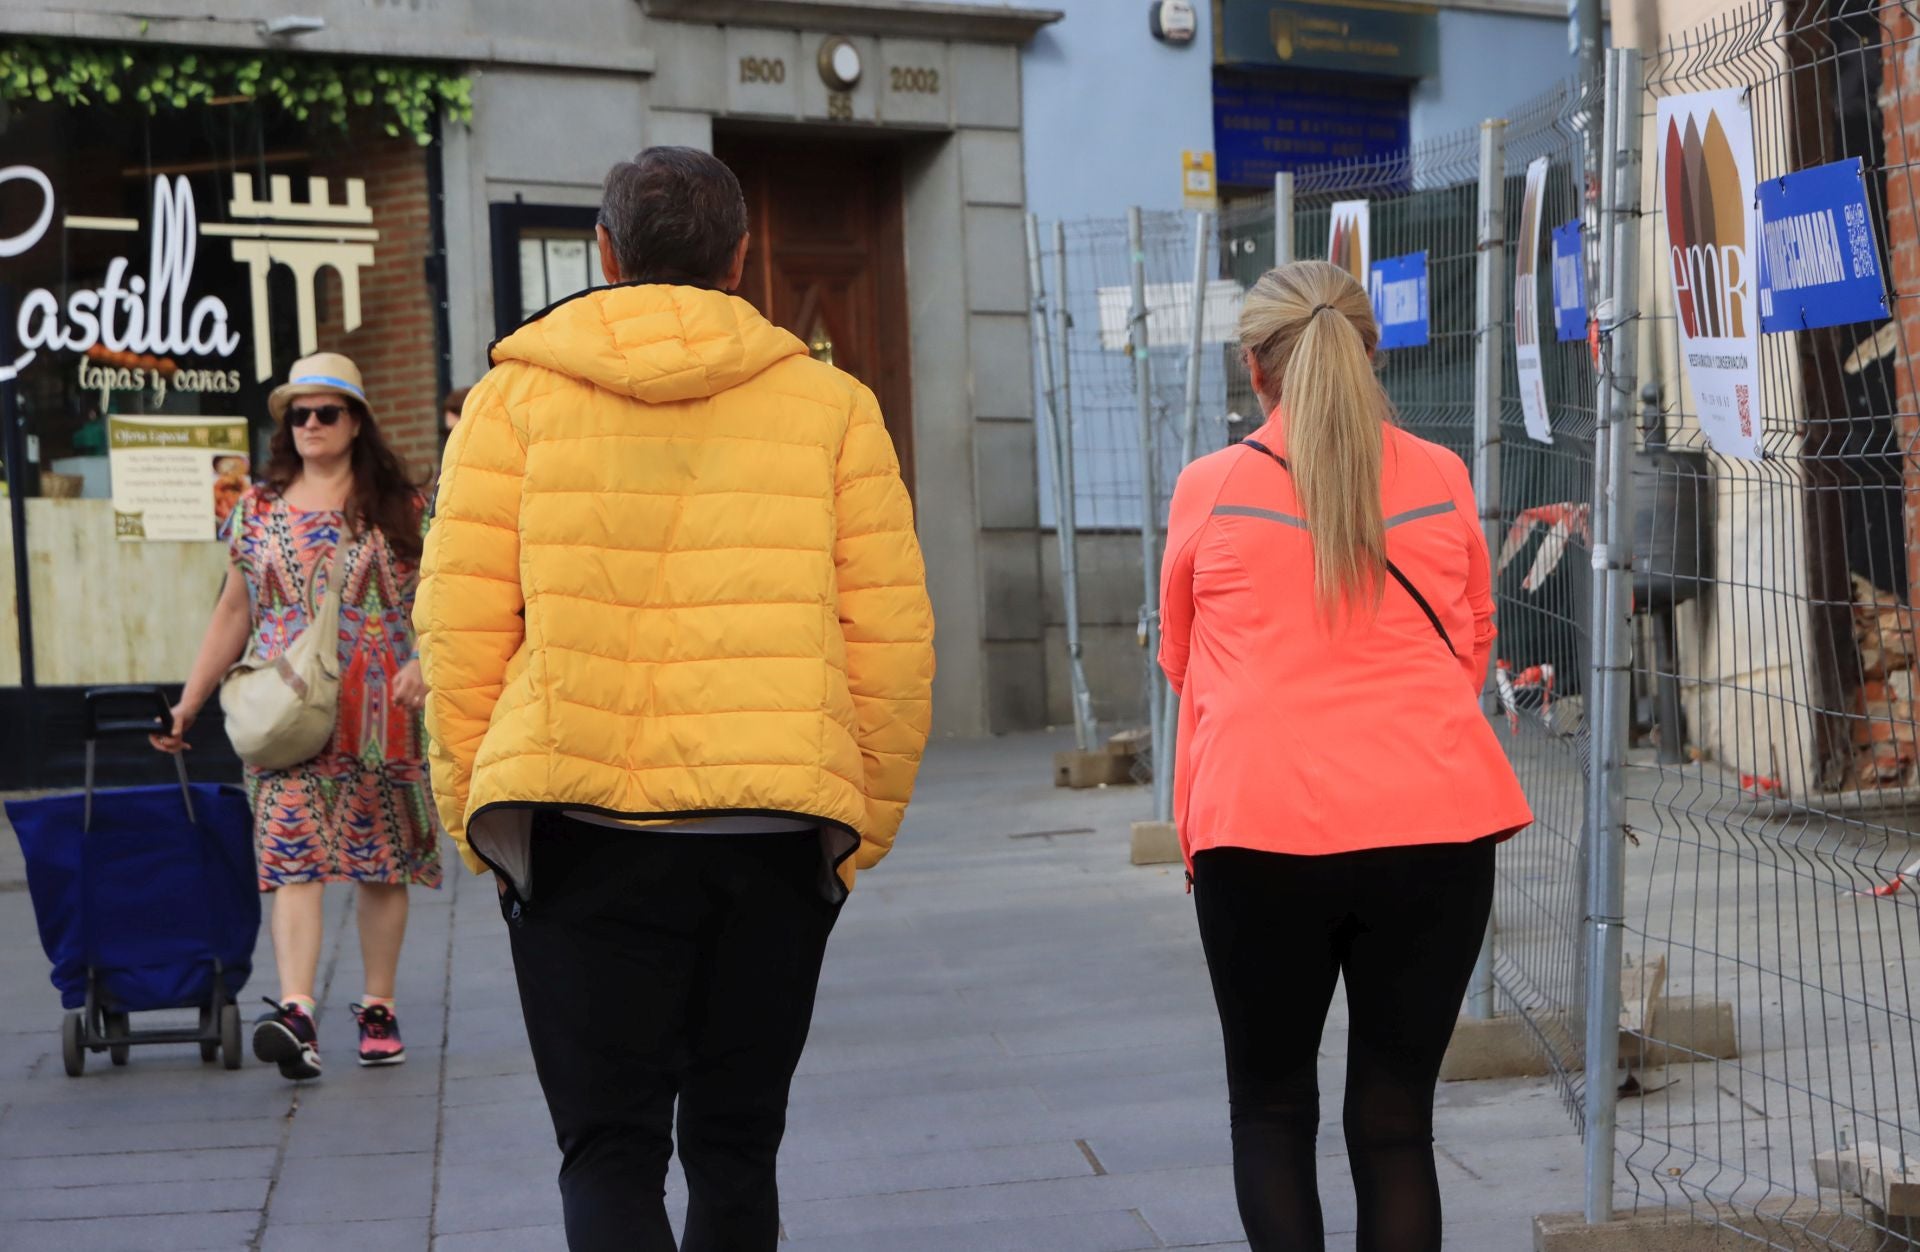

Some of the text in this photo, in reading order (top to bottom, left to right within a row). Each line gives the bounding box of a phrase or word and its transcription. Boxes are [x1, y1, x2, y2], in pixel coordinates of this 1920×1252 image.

[738, 57, 785, 84] 1900
[890, 66, 939, 94] 2002
[78, 354, 145, 415] tapas
[150, 368, 167, 409] y
